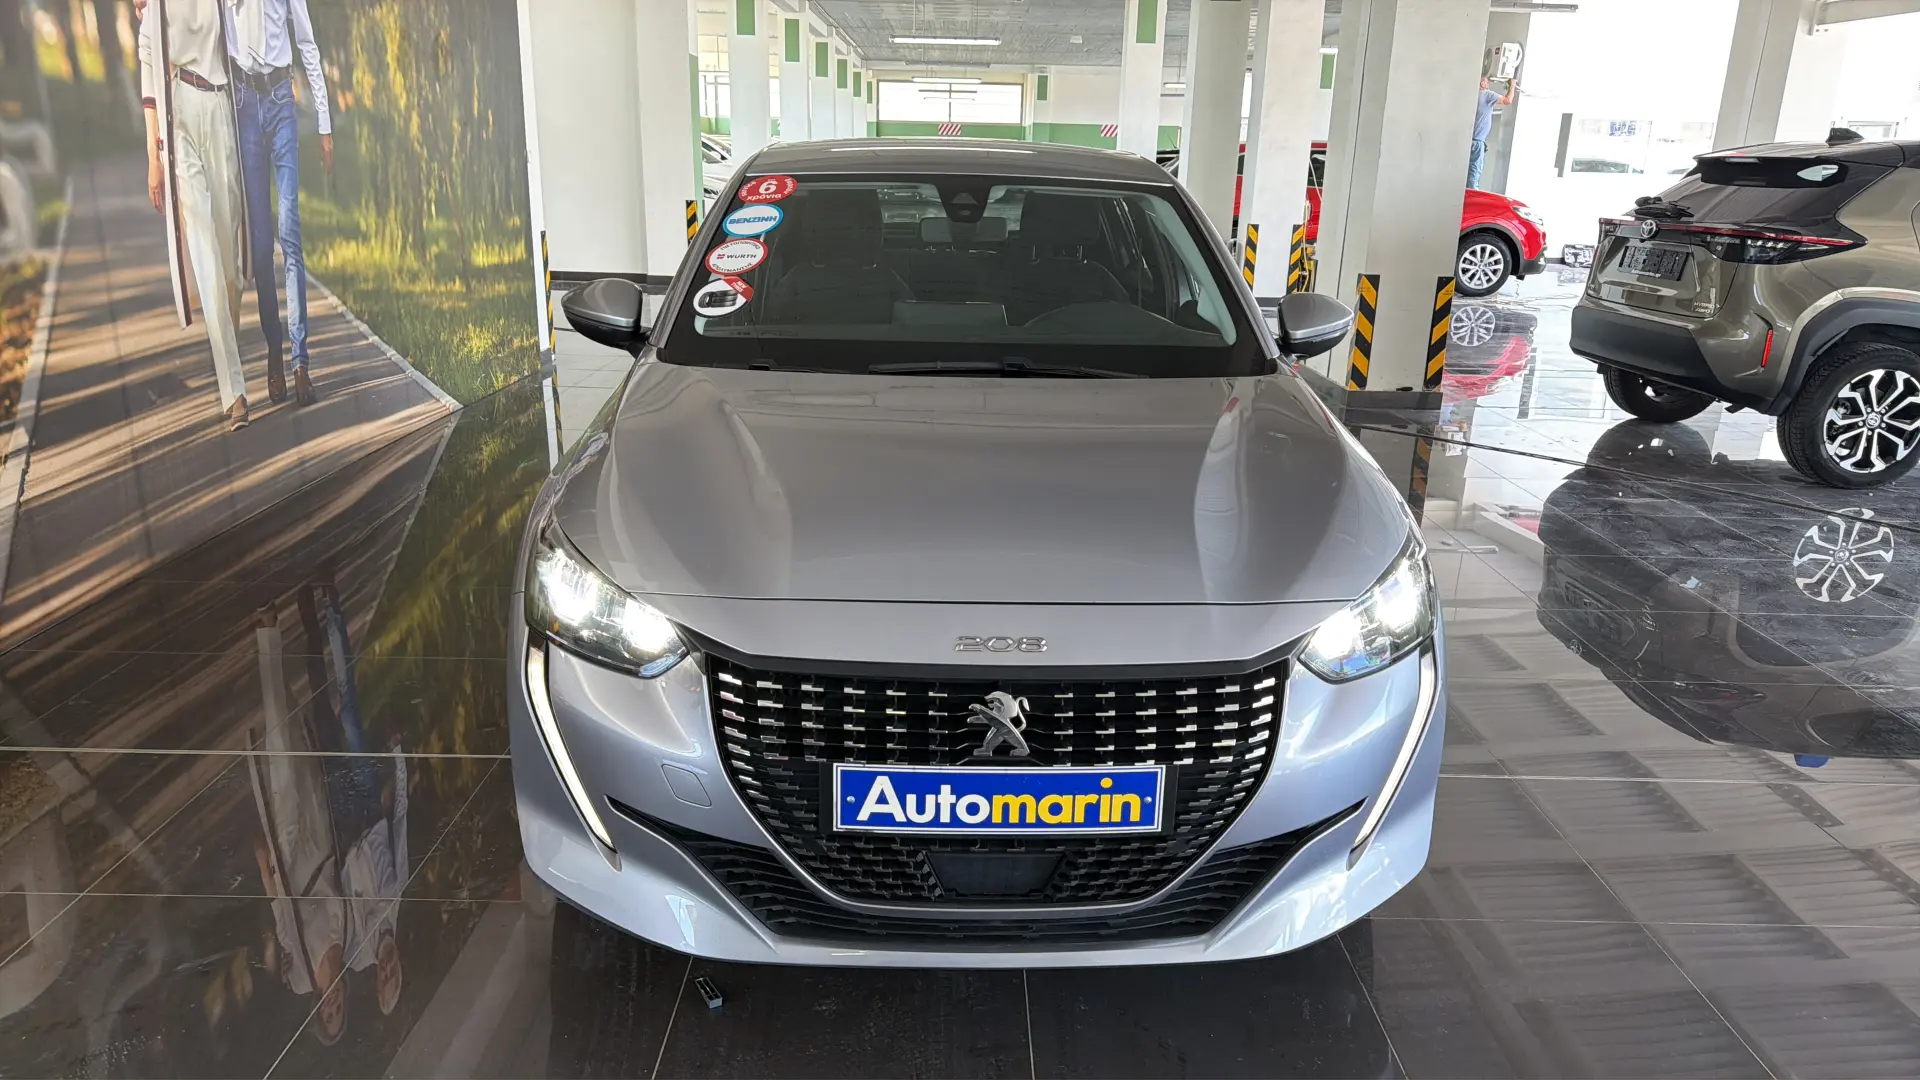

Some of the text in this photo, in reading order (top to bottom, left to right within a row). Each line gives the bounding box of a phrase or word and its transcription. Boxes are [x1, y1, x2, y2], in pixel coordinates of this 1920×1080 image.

[758, 180, 778, 194] 6
[746, 193, 782, 201] χρόνια
[955, 636, 1048, 652] 208
[856, 775, 1141, 824] Automarin
